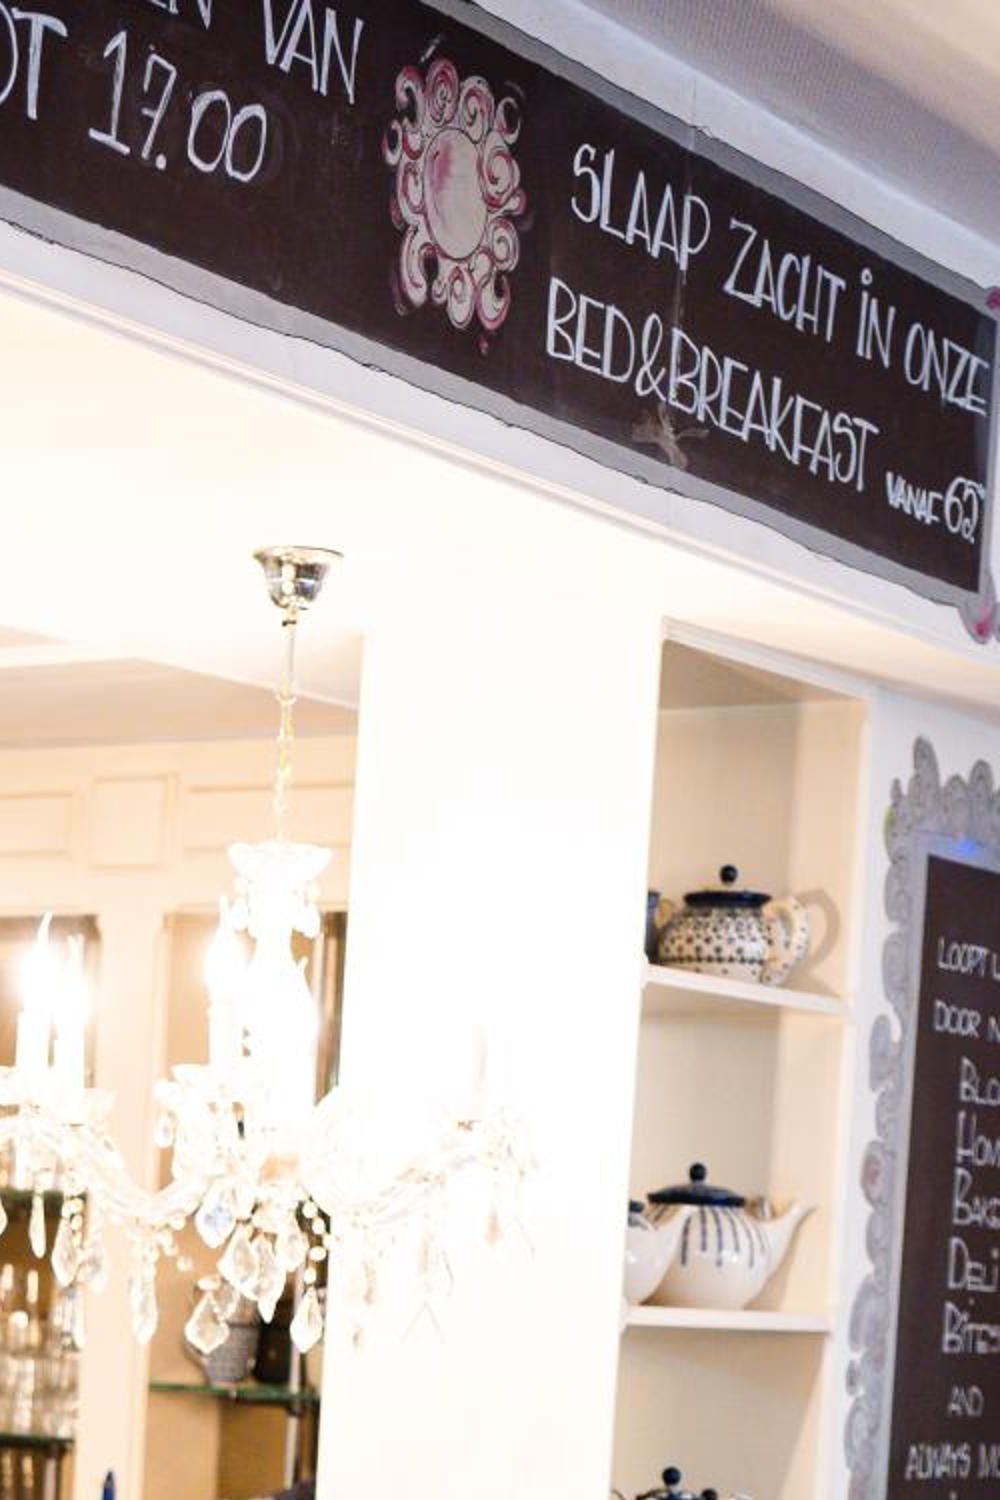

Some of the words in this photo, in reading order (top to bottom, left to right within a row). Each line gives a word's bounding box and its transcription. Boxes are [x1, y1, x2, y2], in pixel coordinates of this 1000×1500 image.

[88, 31, 267, 183] 17.00
[263, 0, 364, 104] VAN
[571, 143, 711, 272] SLAAP
[723, 217, 847, 343] ZACHT
[904, 322, 990, 417] ONZE
[546, 276, 880, 493] BED&BREAKFAST
[933, 999, 982, 1038] DOOR
[904, 1442, 971, 1480] ALWAYS
